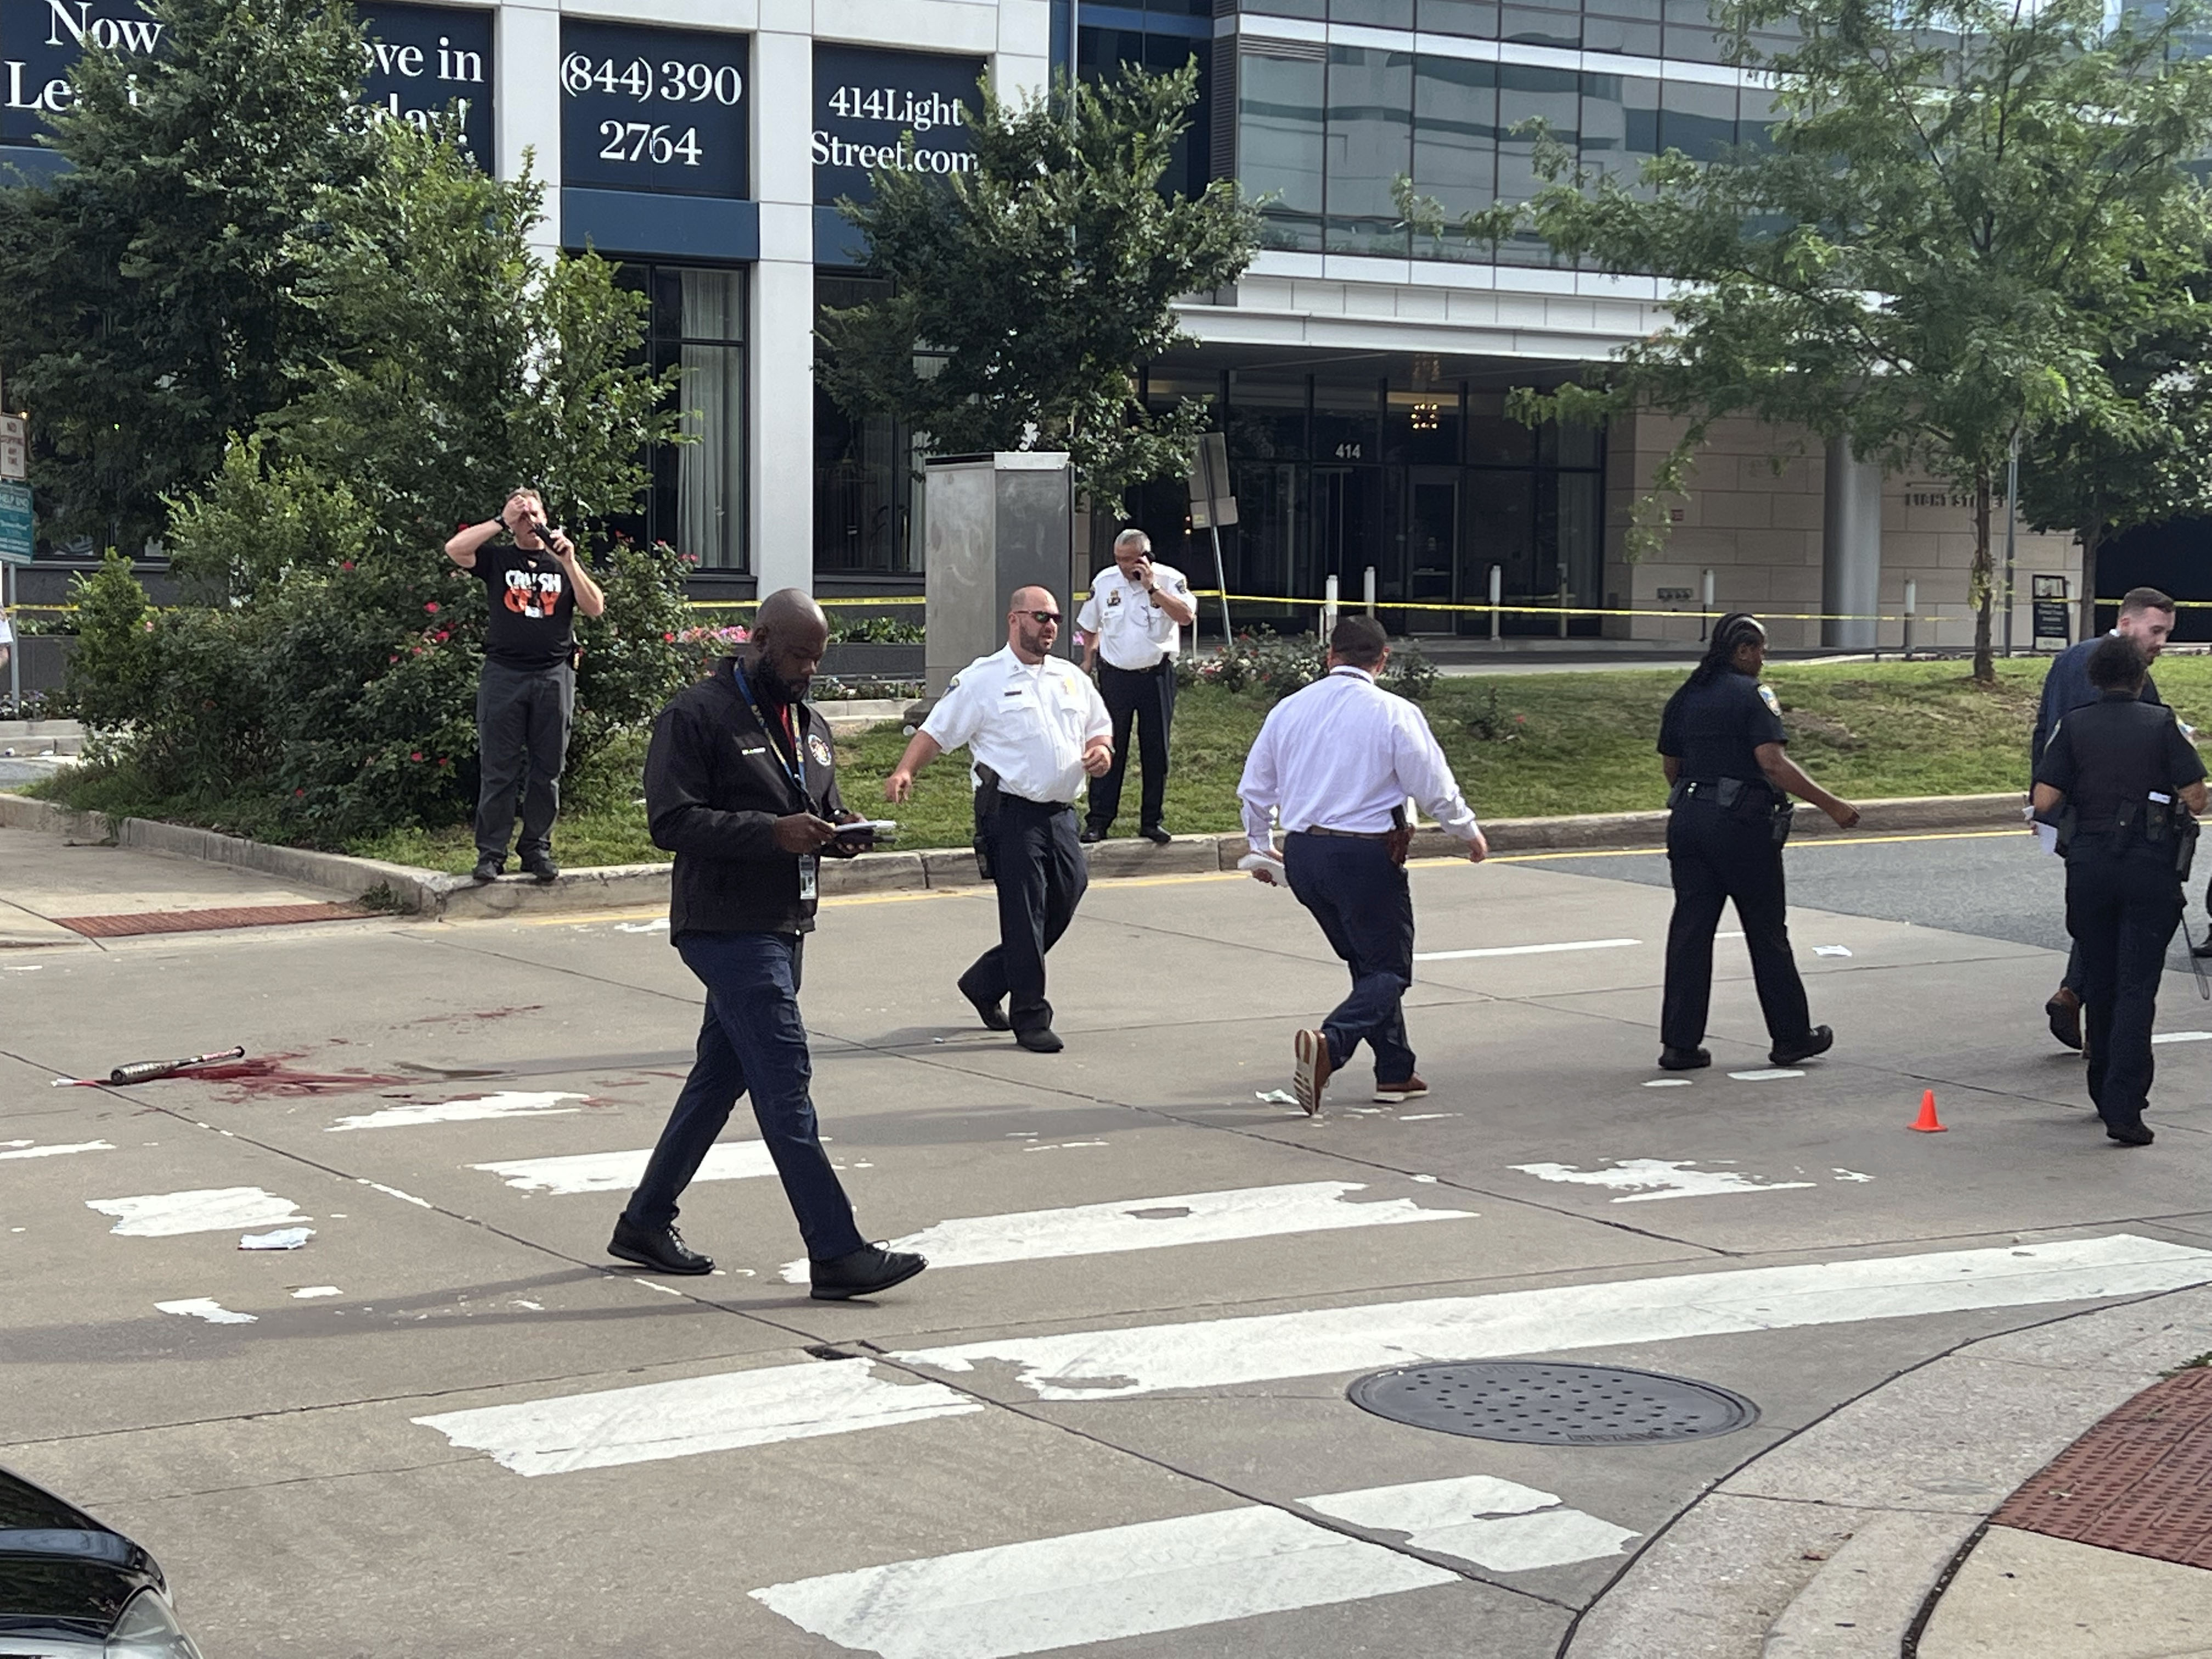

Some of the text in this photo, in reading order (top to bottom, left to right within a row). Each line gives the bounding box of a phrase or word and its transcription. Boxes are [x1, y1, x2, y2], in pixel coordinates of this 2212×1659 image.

[44, 0, 165, 54] Now
[437, 36, 484, 82] in
[599, 120, 703, 166] 2764
[1335, 443, 1361, 459] 414
